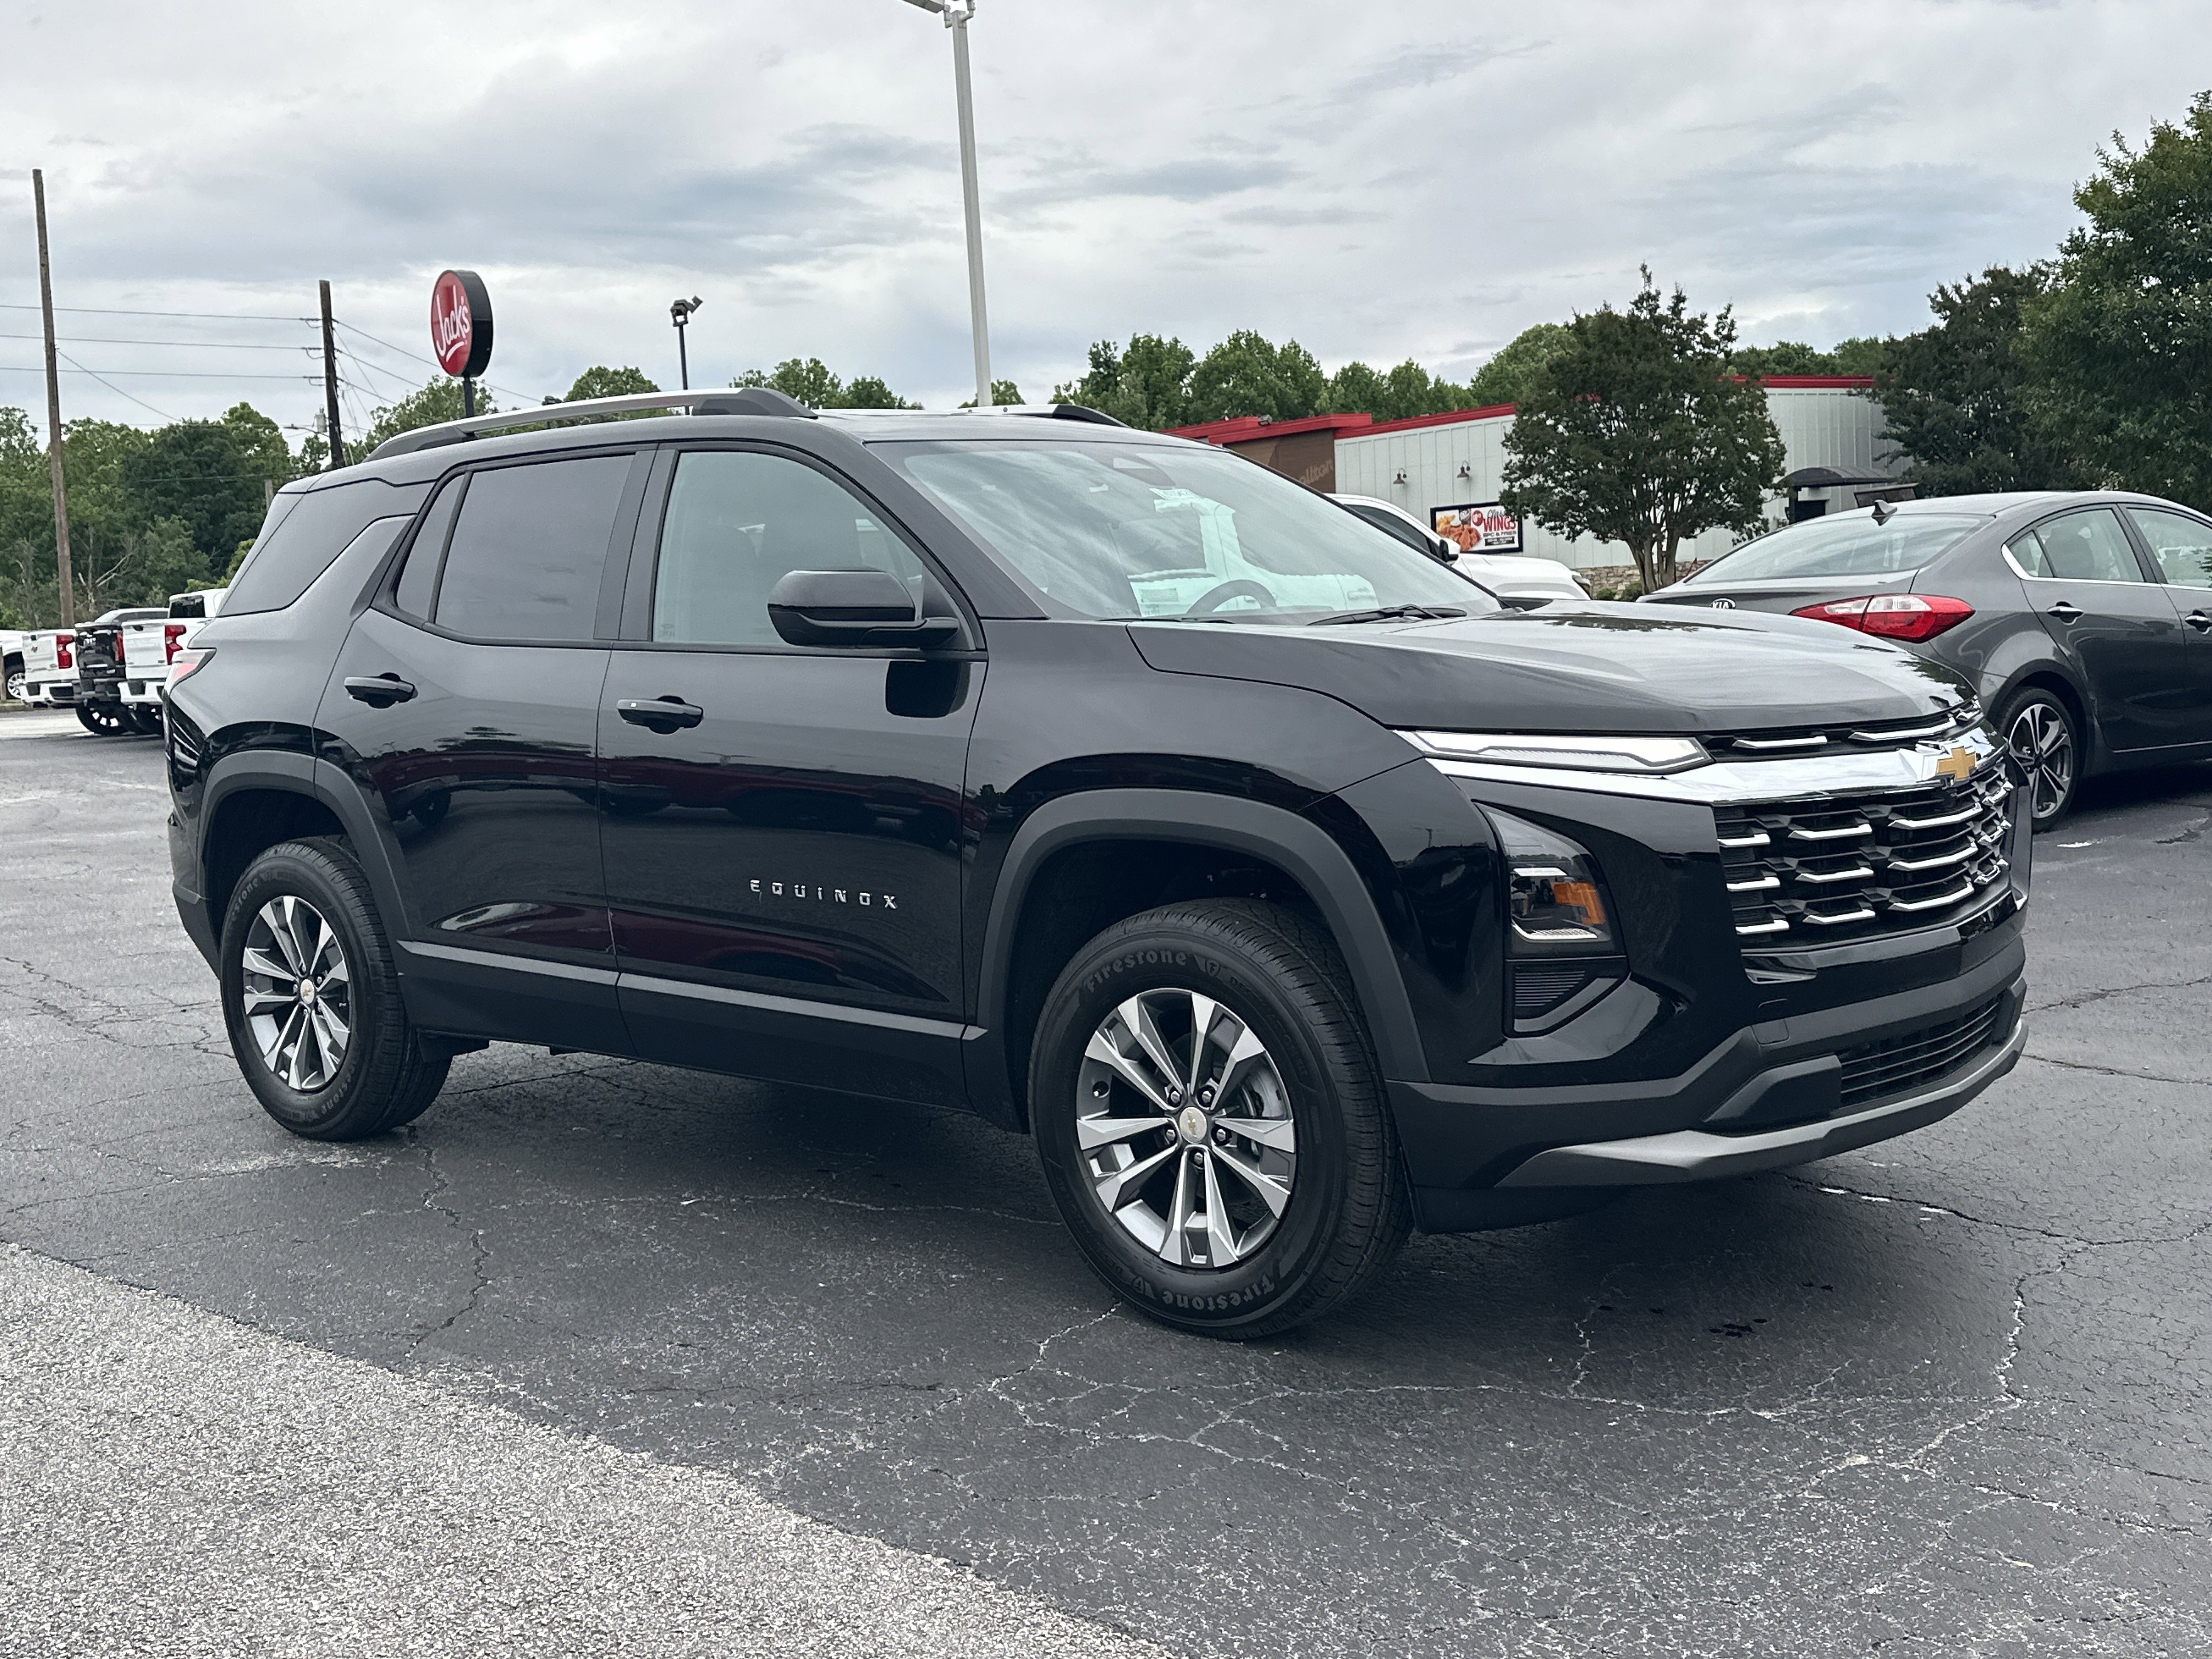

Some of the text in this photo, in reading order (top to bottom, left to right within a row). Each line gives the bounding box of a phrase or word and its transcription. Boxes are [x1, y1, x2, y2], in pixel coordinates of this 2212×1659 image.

[436, 285, 470, 357] Jack's
[1483, 515, 1516, 532] WINGS
[749, 879, 898, 909] EQUINOX
[1083, 950, 1187, 994] Firestone
[1161, 1273, 1276, 1312] Firestone
